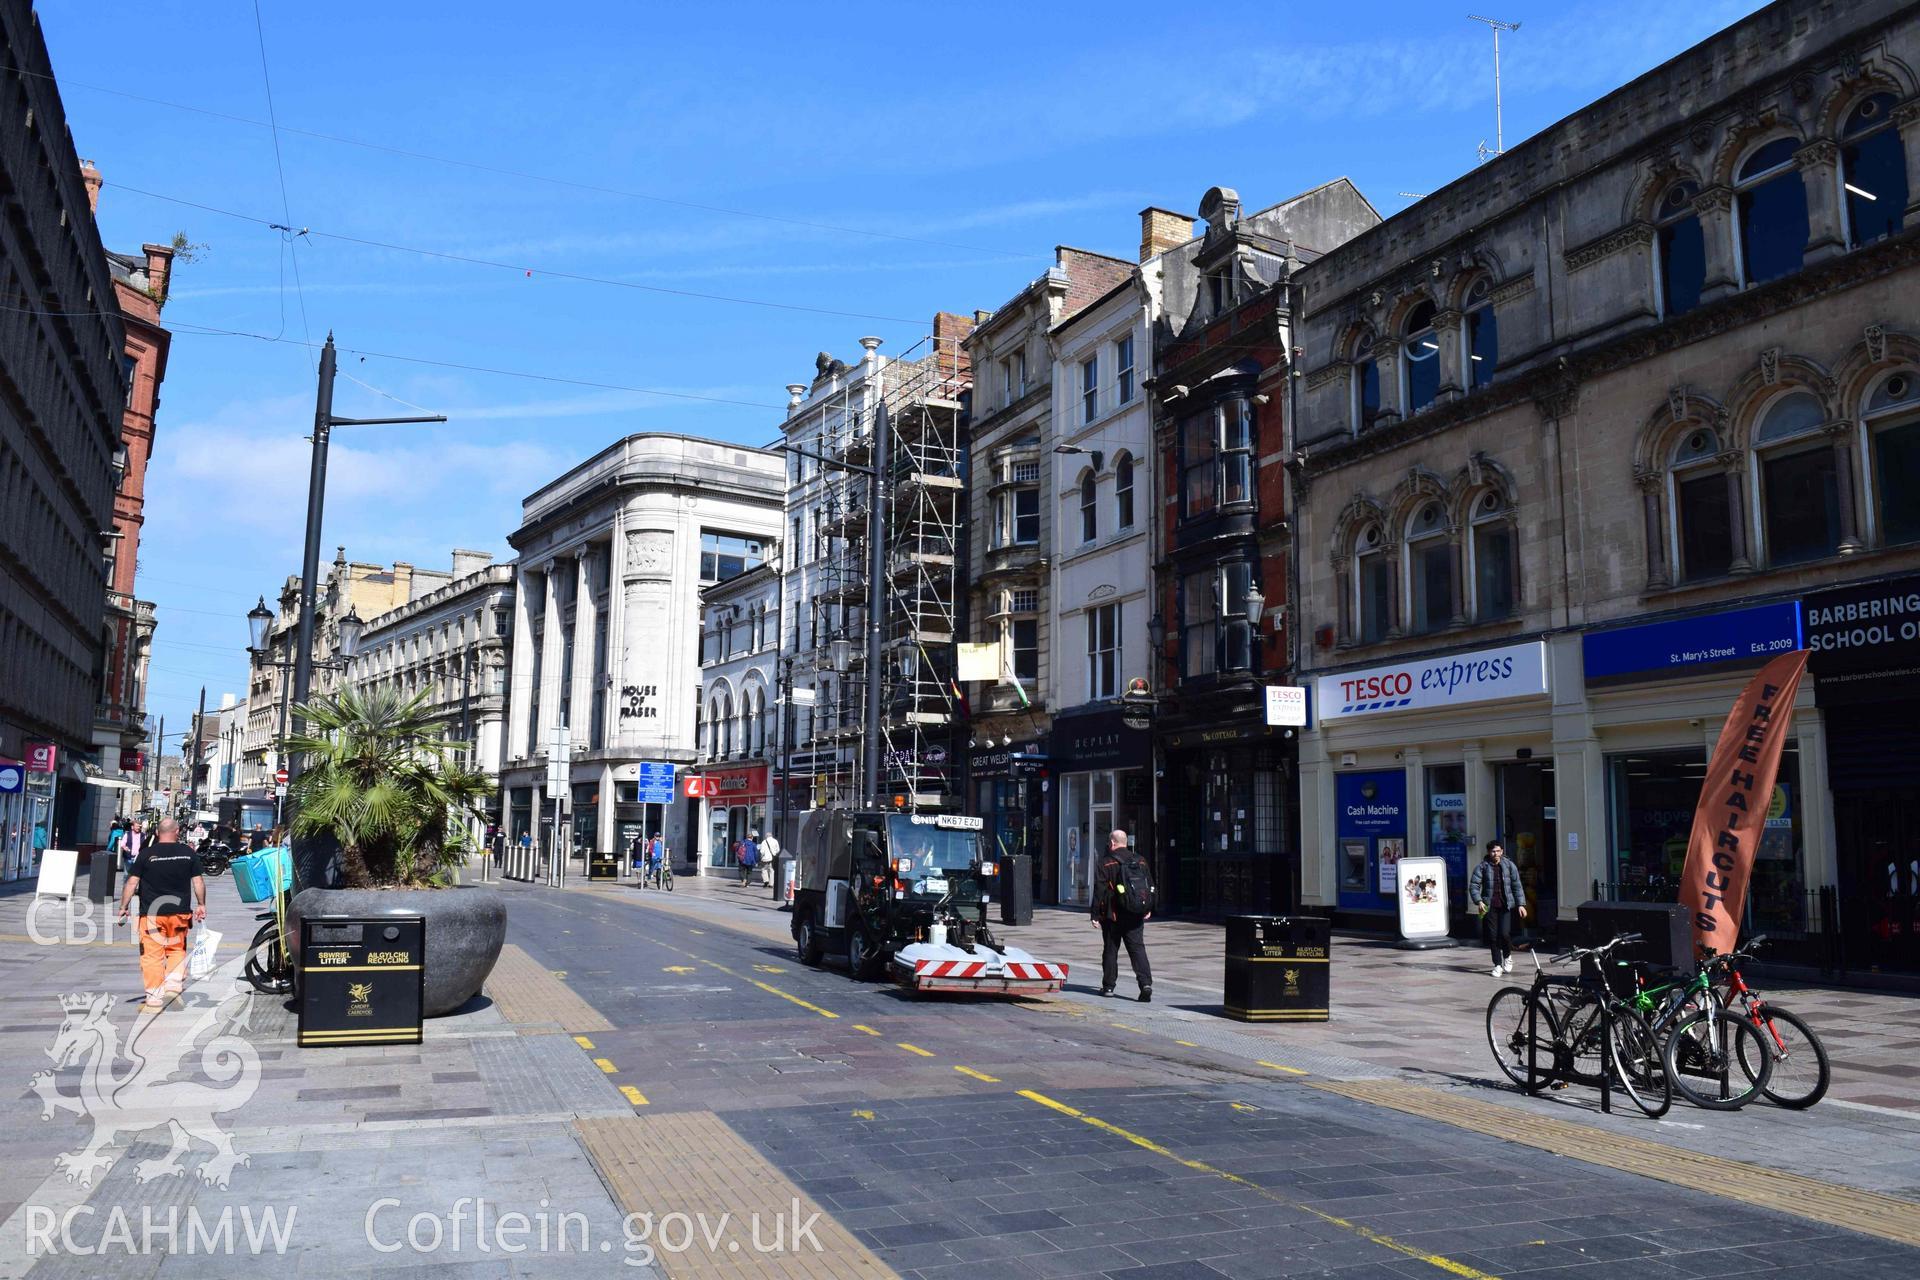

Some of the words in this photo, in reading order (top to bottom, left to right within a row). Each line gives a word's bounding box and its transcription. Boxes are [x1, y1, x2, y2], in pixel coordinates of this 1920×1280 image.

[1808, 593, 1920, 627] BARBERING
[1809, 625, 1894, 652] SCHOOL
[1751, 642, 1768, 653] Est.
[1769, 638, 1792, 651] 2009
[1670, 653, 1681, 663] St.
[1682, 649, 1709, 662] Mary's
[1709, 646, 1736, 658] Street
[1340, 672, 1413, 702] TESCO
[1421, 656, 1513, 695] express
[622, 685, 657, 696] HOUSE
[1271, 690, 1302, 700] TESCO
[630, 696, 645, 707] OF
[620, 706, 657, 718] FRASER
[1738, 683, 1779, 765] FREE
[972, 756, 989, 767] GREAT
[990, 753, 1009, 765] WELSH
[1435, 798, 1464, 808] Croeso.
[1347, 805, 1366, 816] Cash
[1367, 804, 1399, 816] Machine
[941, 816, 963, 825] NK67
[964, 818, 980, 827] EZU
[1695, 769, 1755, 933] HAIRCUTS
[320, 957, 347, 965] LITTER
[367, 951, 409, 959] AILGYLCHU
